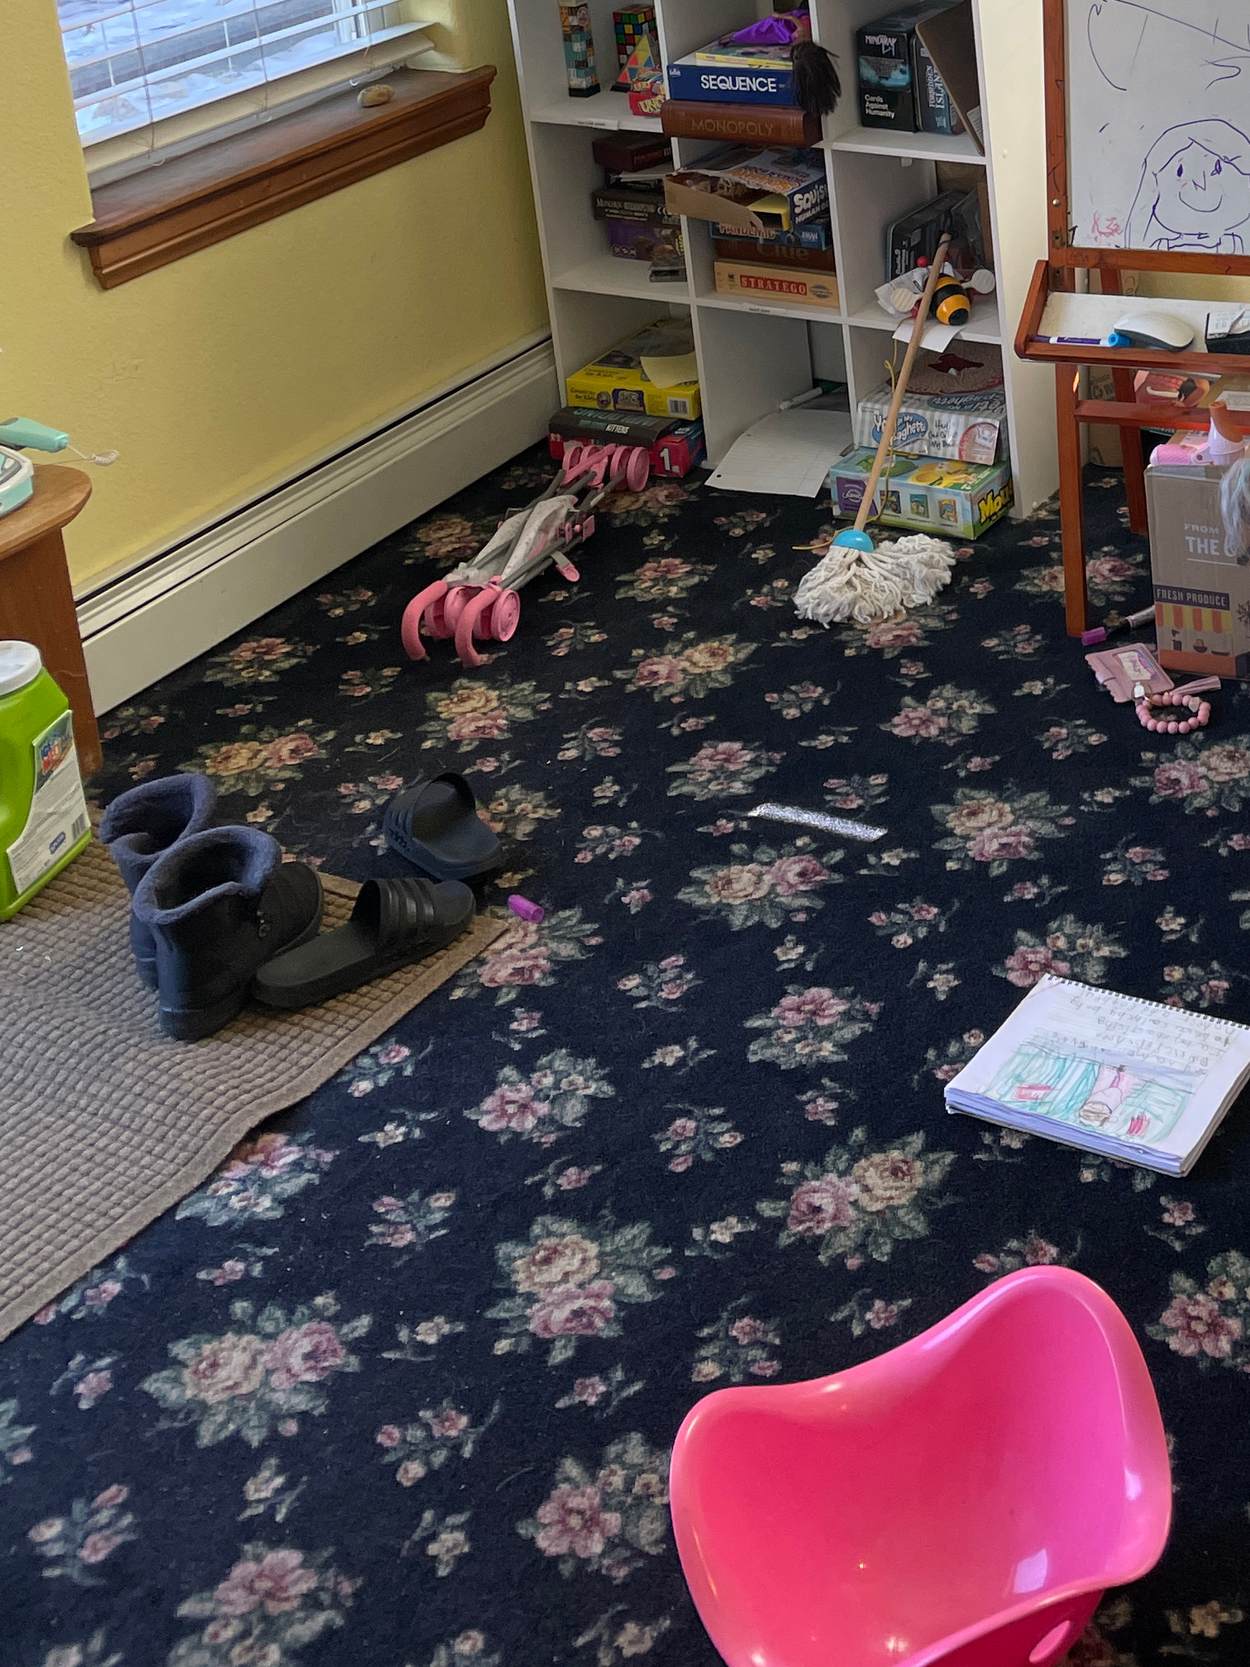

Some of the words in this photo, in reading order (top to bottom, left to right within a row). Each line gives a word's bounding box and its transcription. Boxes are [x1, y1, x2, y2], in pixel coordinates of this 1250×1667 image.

[700, 75, 777, 92] SEQUENCE
[864, 94, 883, 102] Cards
[691, 118, 773, 136] MONOPOLY
[742, 278, 806, 295] STRATEGO
[1184, 524, 1219, 534] FROM
[1185, 536, 1220, 556] THE
[1156, 588, 1184, 601] FRESH
[1186, 592, 1226, 607] PRODUCE
